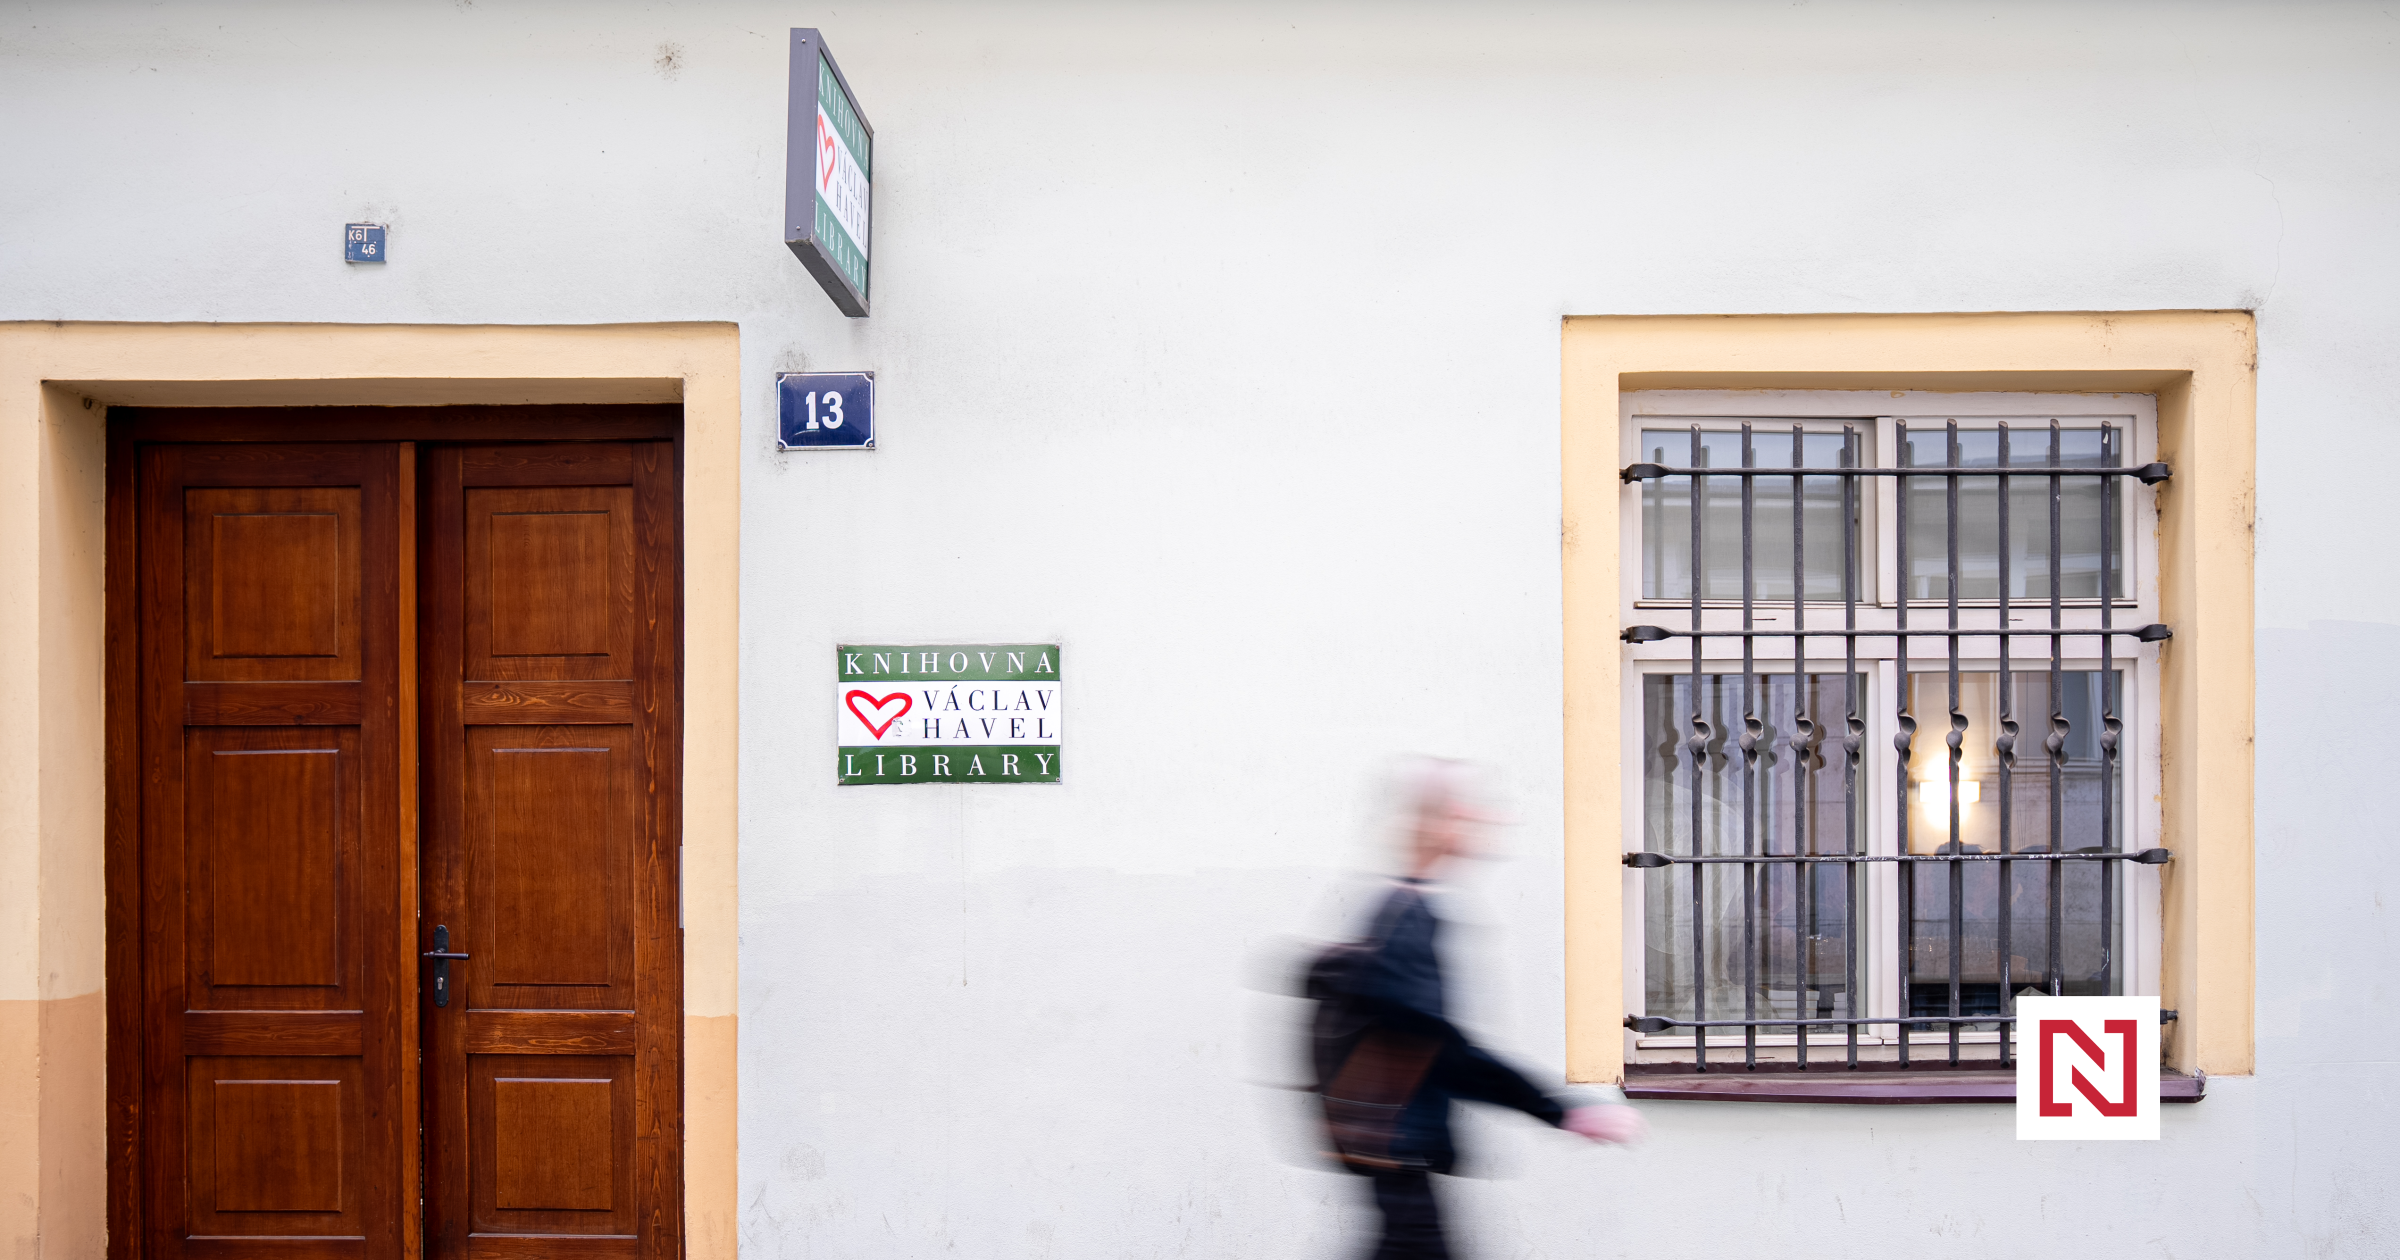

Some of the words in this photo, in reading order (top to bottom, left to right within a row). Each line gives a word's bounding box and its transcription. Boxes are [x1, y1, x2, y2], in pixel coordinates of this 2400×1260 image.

[818, 61, 869, 171] KNIHOVNA
[836, 145, 869, 212] VÁCLAV
[835, 180, 867, 249] HAVEL
[361, 243, 376, 255] 46
[815, 201, 867, 295] LIBRARY
[805, 391, 844, 430] 13
[844, 652, 1054, 675] KNIHOVNA
[922, 684, 1054, 712] VÁCLAV
[922, 717, 1053, 739] HAVEL
[844, 753, 1055, 777] LIBRARY
